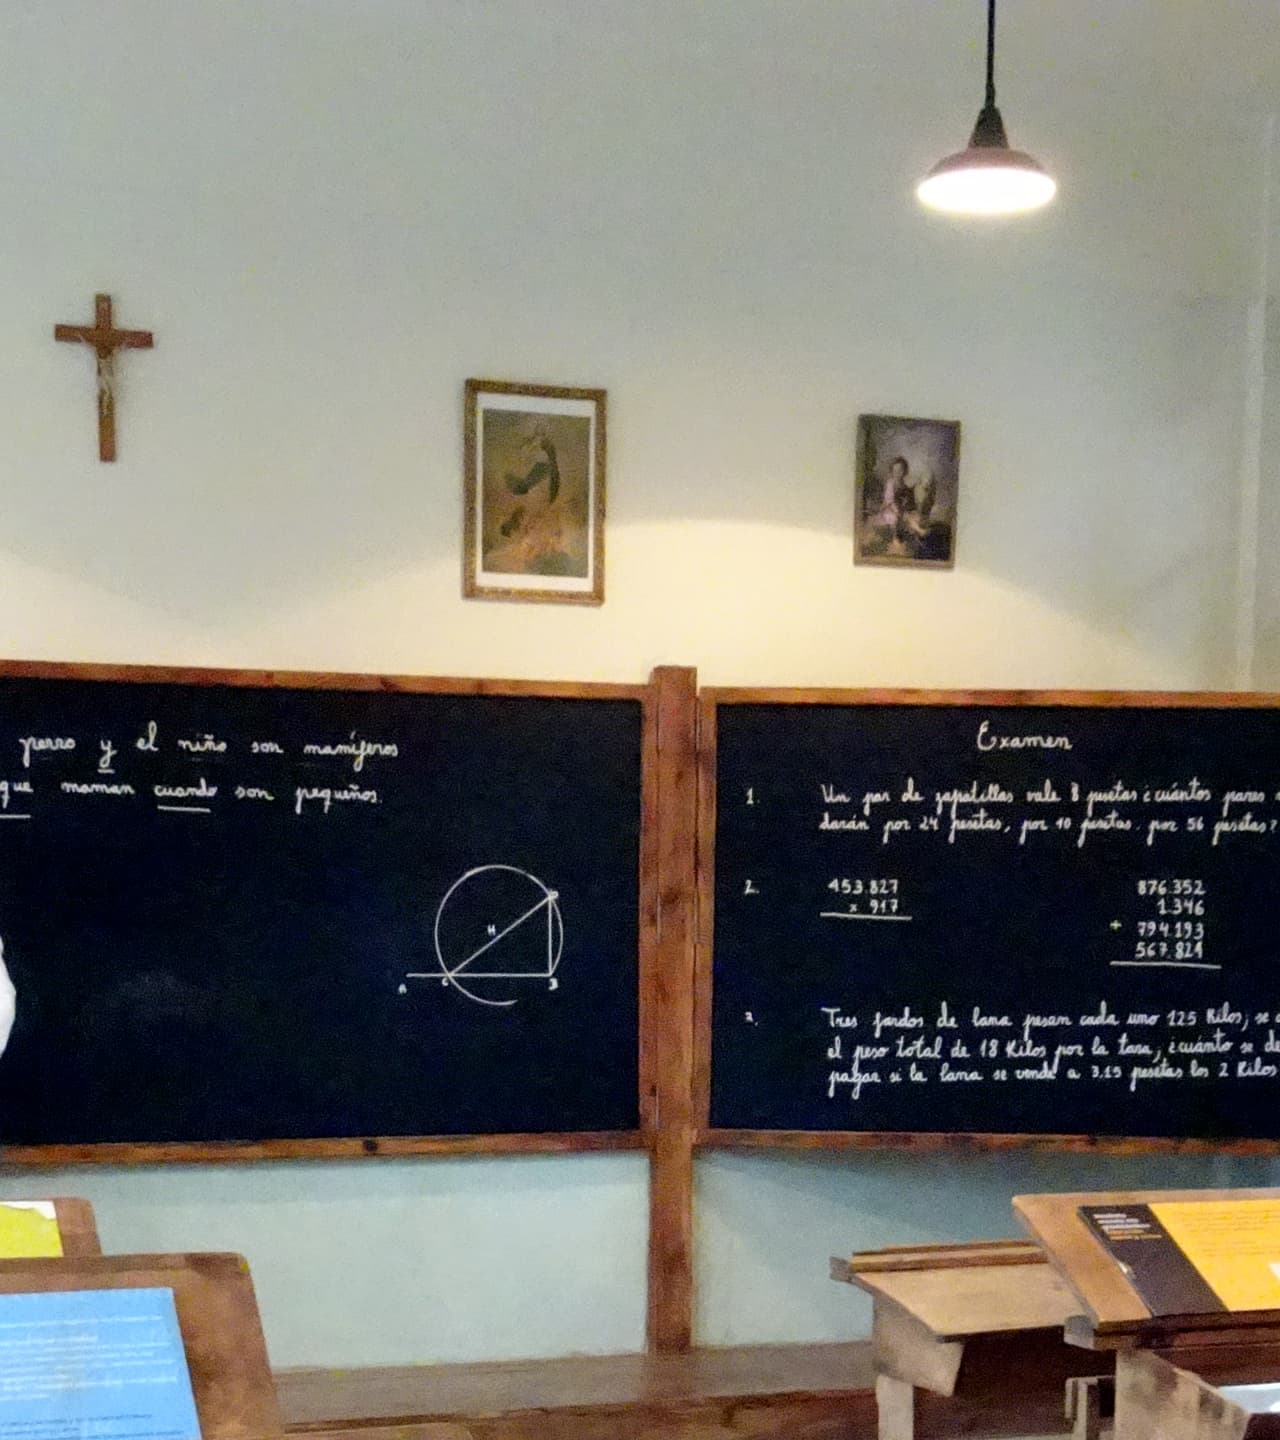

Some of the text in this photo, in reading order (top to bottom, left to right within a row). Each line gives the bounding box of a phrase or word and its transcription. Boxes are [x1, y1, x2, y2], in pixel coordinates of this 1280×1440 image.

[19, 736, 76, 768] perro
[98, 739, 118, 769] y
[136, 720, 160, 752] el
[177, 733, 228, 753] niño
[251, 741, 284, 754] son
[303, 731, 398, 773] mamíferos
[977, 720, 1073, 751] Examen
[61, 782, 135, 796] maman
[154, 778, 218, 798] cuando
[235, 785, 275, 801] son
[821, 783, 851, 803] Un
[863, 791, 892, 816] par
[901, 777, 924, 803] de
[936, 780, 1015, 818] zapatillas
[1027, 779, 1062, 803] vale
[1087, 779, 1138, 817] pesetas
[1222, 788, 1266, 817] pares
[820, 811, 869, 831] darán
[883, 817, 911, 844] por
[919, 816, 940, 831] 24
[1020, 816, 1048, 845] por
[1147, 818, 1179, 846] por
[1187, 816, 1205, 831] 56
[869, 898, 900, 915] 917
[820, 1006, 858, 1028] Tres
[872, 1006, 924, 1038] fardos
[937, 1000, 959, 1028] de
[972, 1006, 1013, 1028] lana
[1022, 1012, 1072, 1042] pesan
[1080, 1000, 1120, 1027] cada
[1126, 1011, 1160, 1027] uno
[1167, 1009, 1197, 1027] 125
[1254, 1012, 1270, 1025] se
[827, 1036, 842, 1059] el
[852, 1044, 890, 1075] peso
[895, 1035, 943, 1059] total
[950, 1039, 972, 1059] de
[979, 1038, 999, 1059] 18
[1052, 1044, 1085, 1075] por
[1091, 1035, 1109, 1056] la
[1240, 1041, 1254, 1053] se
[828, 1070, 882, 1100] pagar
[889, 1067, 902, 1082] si
[910, 1061, 928, 1083] la
[939, 1062, 984, 1082] lana
[993, 1068, 1008, 1081] se
[1016, 1060, 1056, 1081] vende
[1067, 1068, 1081, 1080] a
[1130, 1056, 1184, 1092] pesetas
[1190, 1059, 1210, 1078] los
[1219, 1063, 1230, 1078] 2
